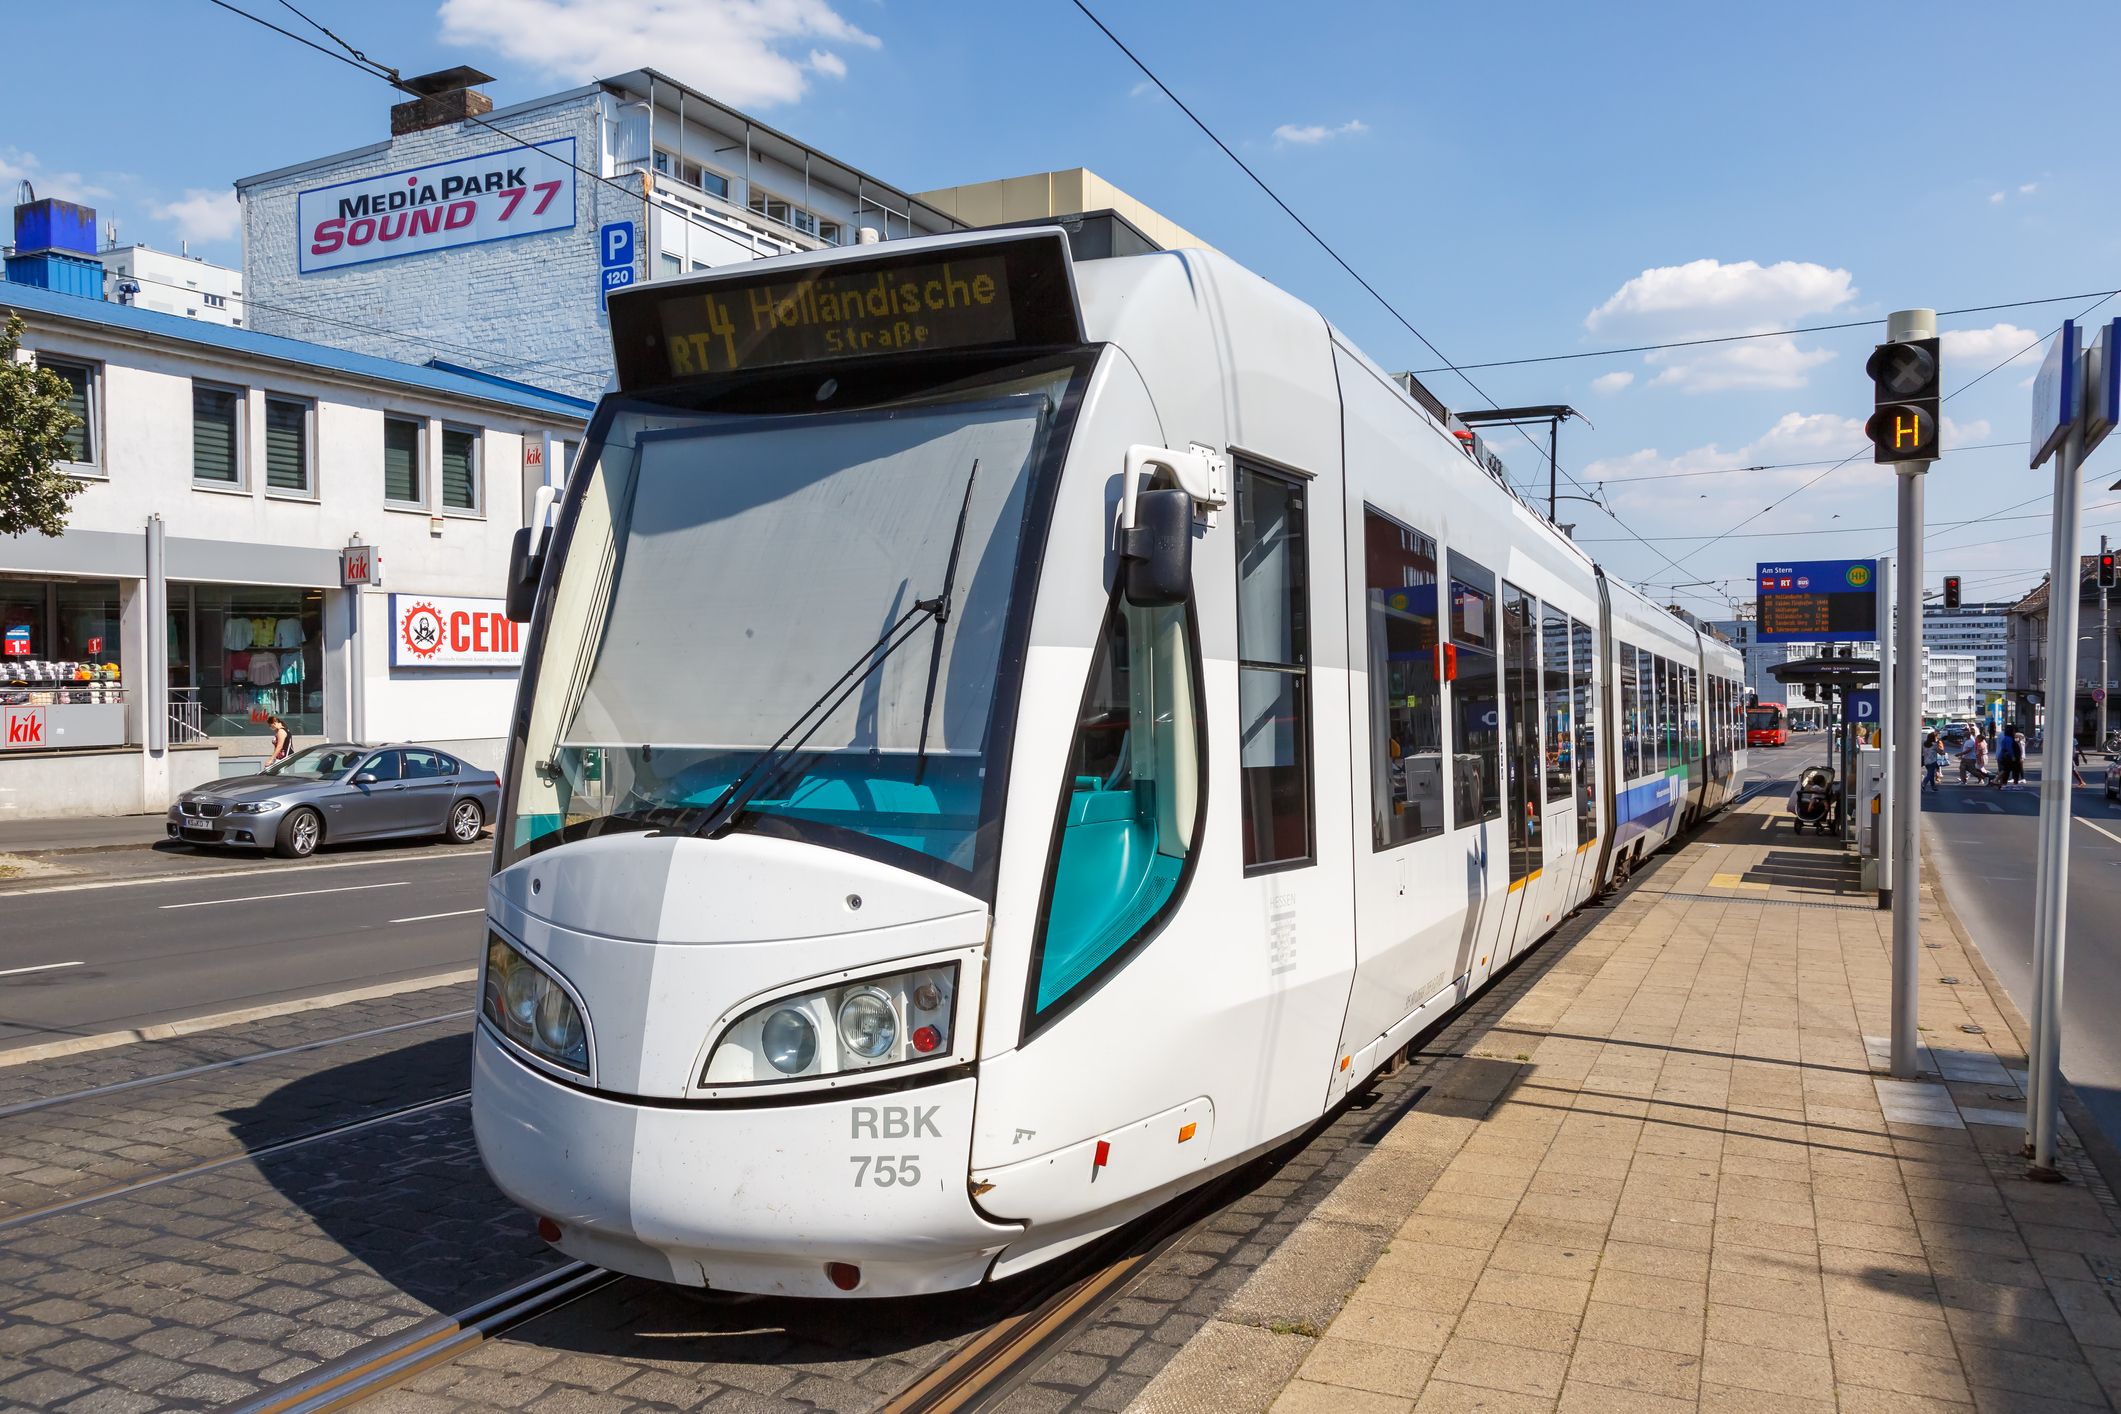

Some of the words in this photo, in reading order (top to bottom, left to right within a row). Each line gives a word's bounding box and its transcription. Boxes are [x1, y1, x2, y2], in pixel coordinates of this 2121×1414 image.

[311, 200, 477, 255] SOUND
[497, 179, 563, 222] 77
[609, 229, 629, 261] P
[606, 271, 629, 285] 120
[750, 263, 996, 331] Holländische
[826, 323, 929, 352] Straße
[526, 446, 541, 465] kik
[348, 553, 368, 579] kik
[1775, 566, 1793, 574] Stern
[1781, 579, 1791, 587] RT
[450, 611, 519, 652] CEM
[1857, 701, 1873, 718] D
[9, 709, 42, 743] kik
[851, 1105, 943, 1139] RBK
[850, 1155, 922, 1188] 755
